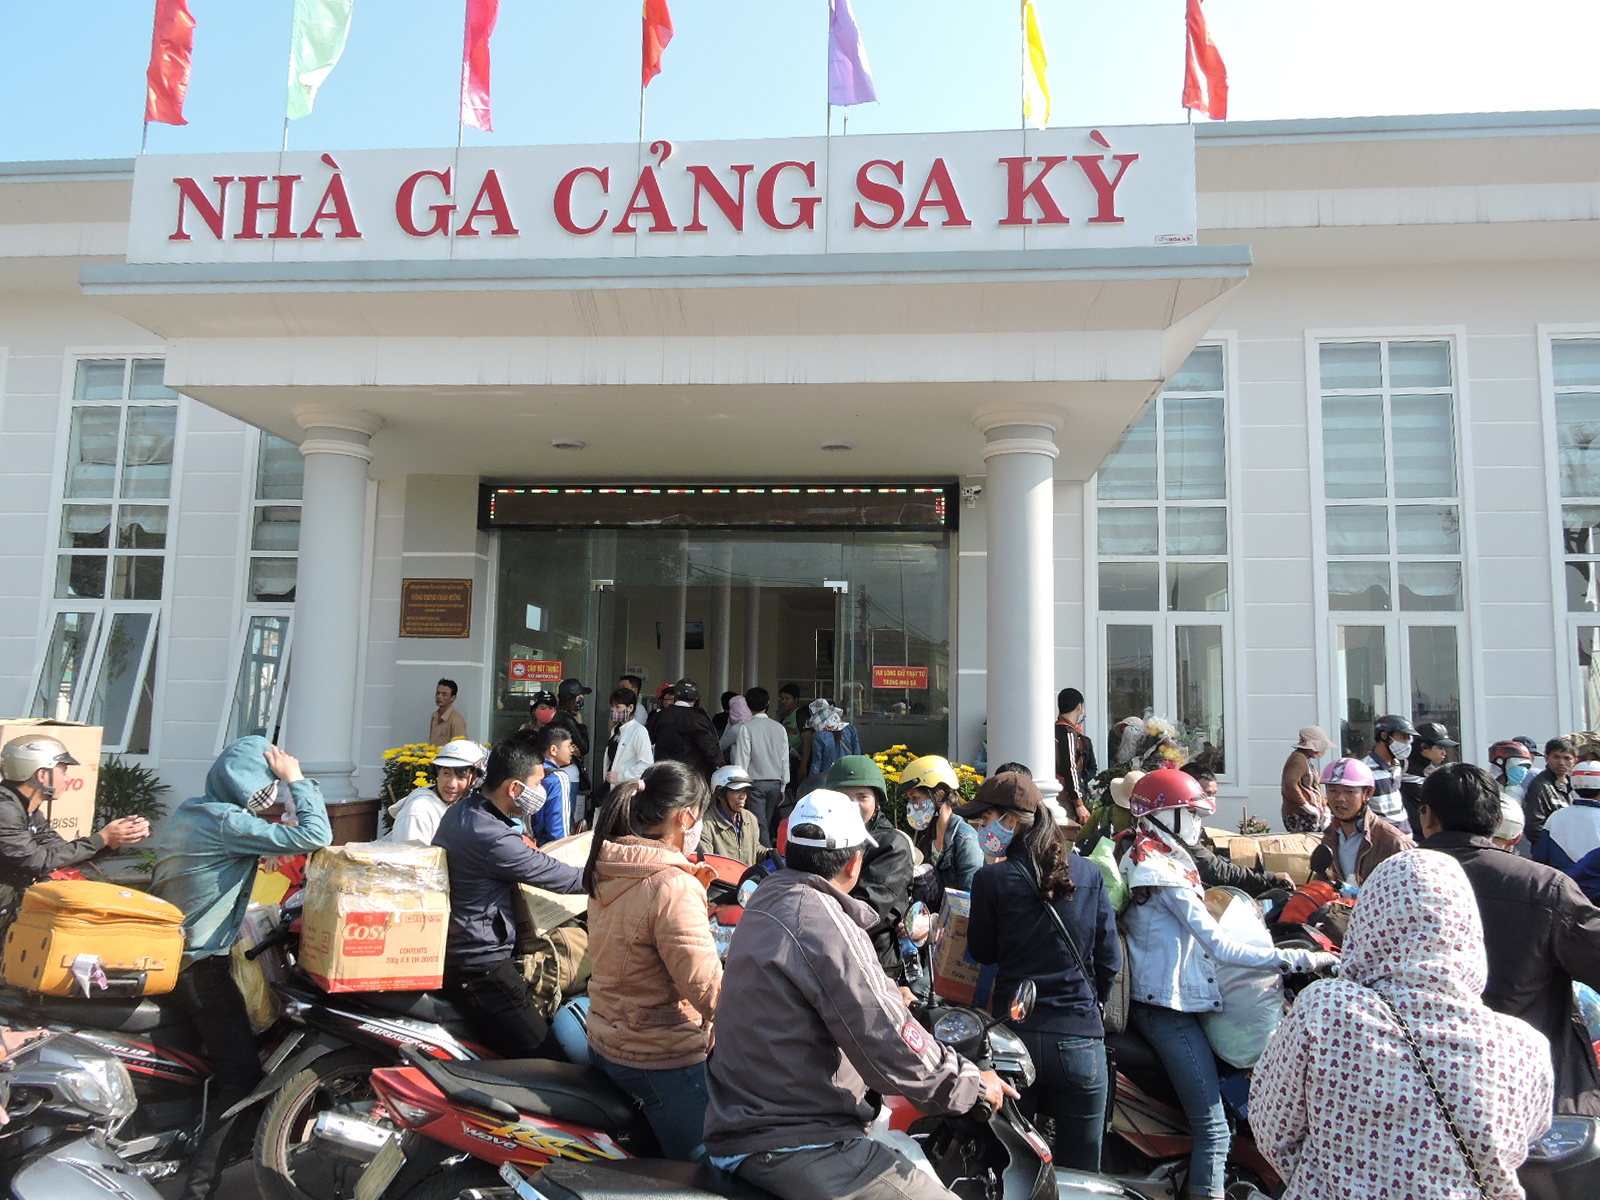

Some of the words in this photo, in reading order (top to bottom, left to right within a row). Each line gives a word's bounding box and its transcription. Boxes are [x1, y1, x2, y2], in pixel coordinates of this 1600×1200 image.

[168, 153, 362, 240] NHÀ
[395, 166, 520, 237] GA
[553, 139, 822, 235] CẢNG
[854, 157, 973, 230] SA
[998, 128, 1140, 226] KỲ
[342, 922, 392, 940] COSY
[910, 1030, 920, 1045] 10
